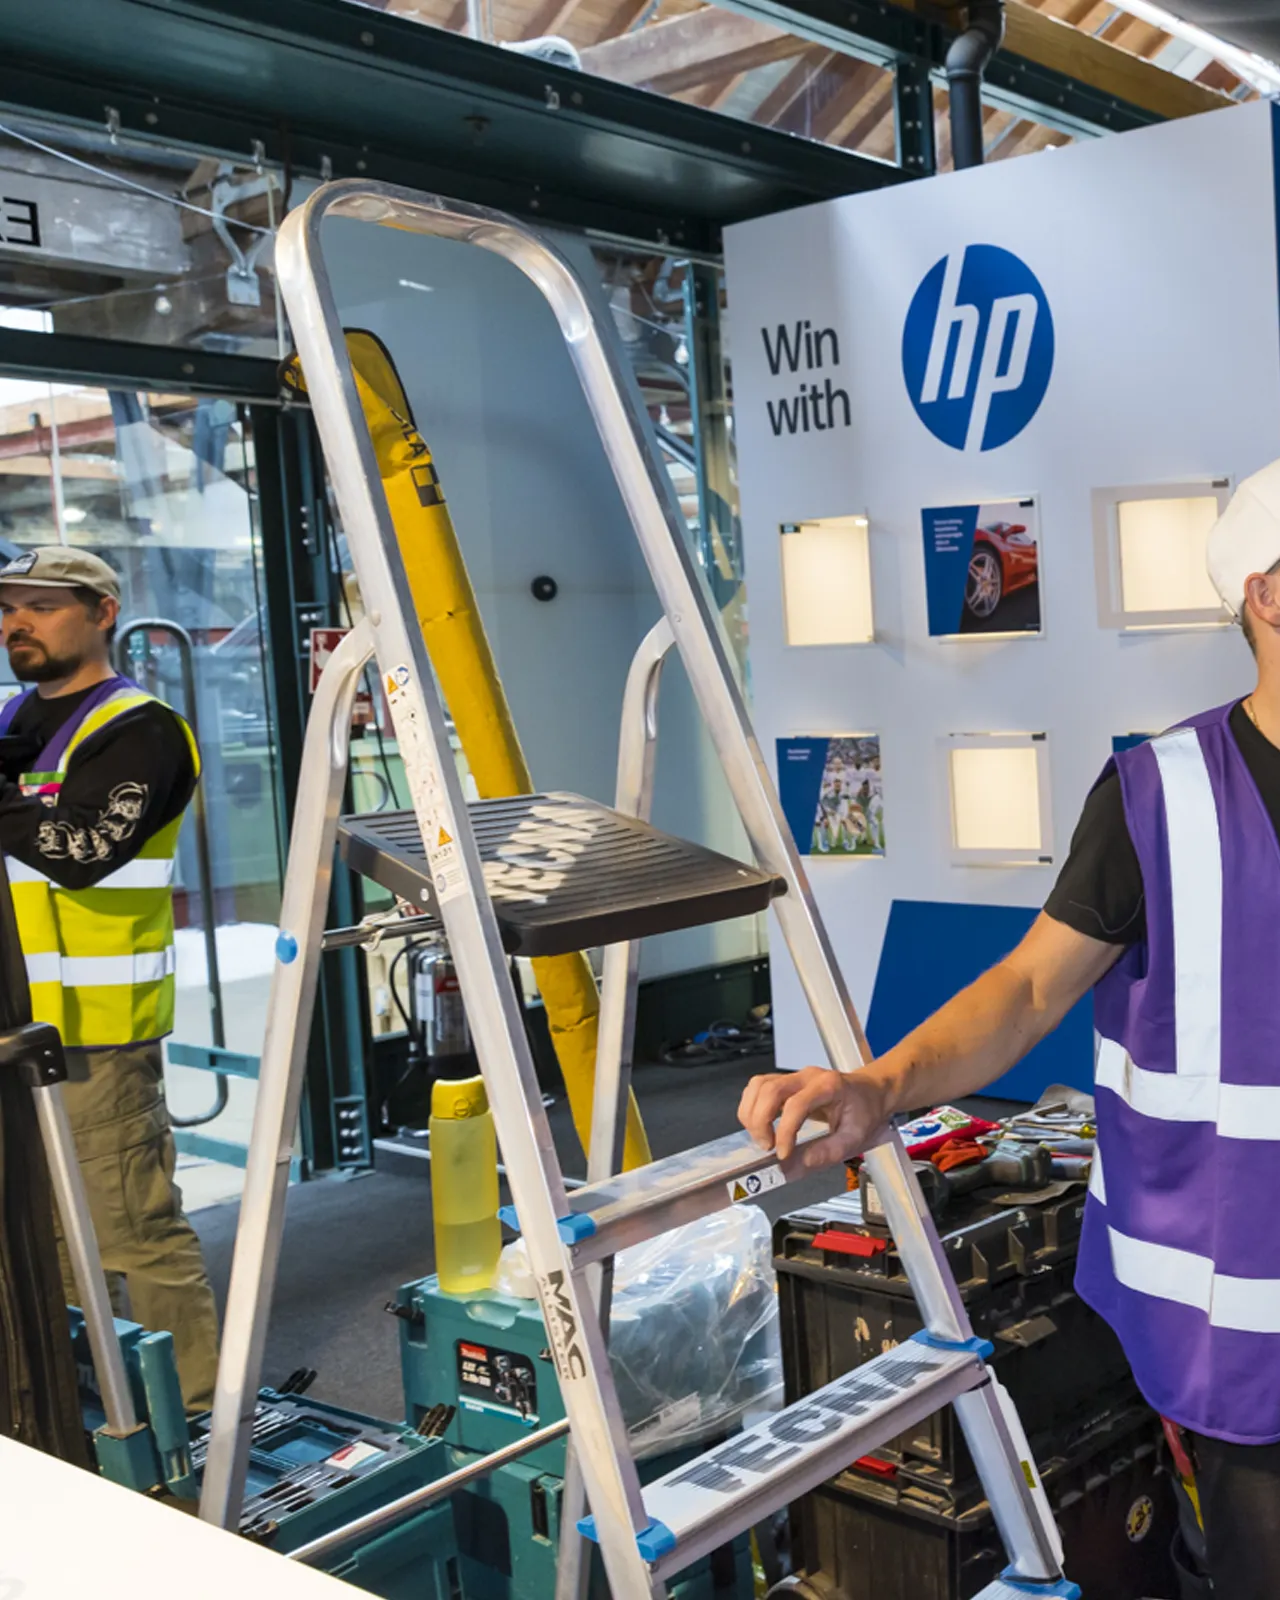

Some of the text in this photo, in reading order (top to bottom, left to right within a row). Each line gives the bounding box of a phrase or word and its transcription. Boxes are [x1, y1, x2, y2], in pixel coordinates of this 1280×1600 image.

[761, 320, 840, 376] Win
[917, 243, 1040, 452] hp
[766, 378, 851, 437] with
[547, 1269, 587, 1381] MAC
[663, 1359, 945, 1493] TECNA
